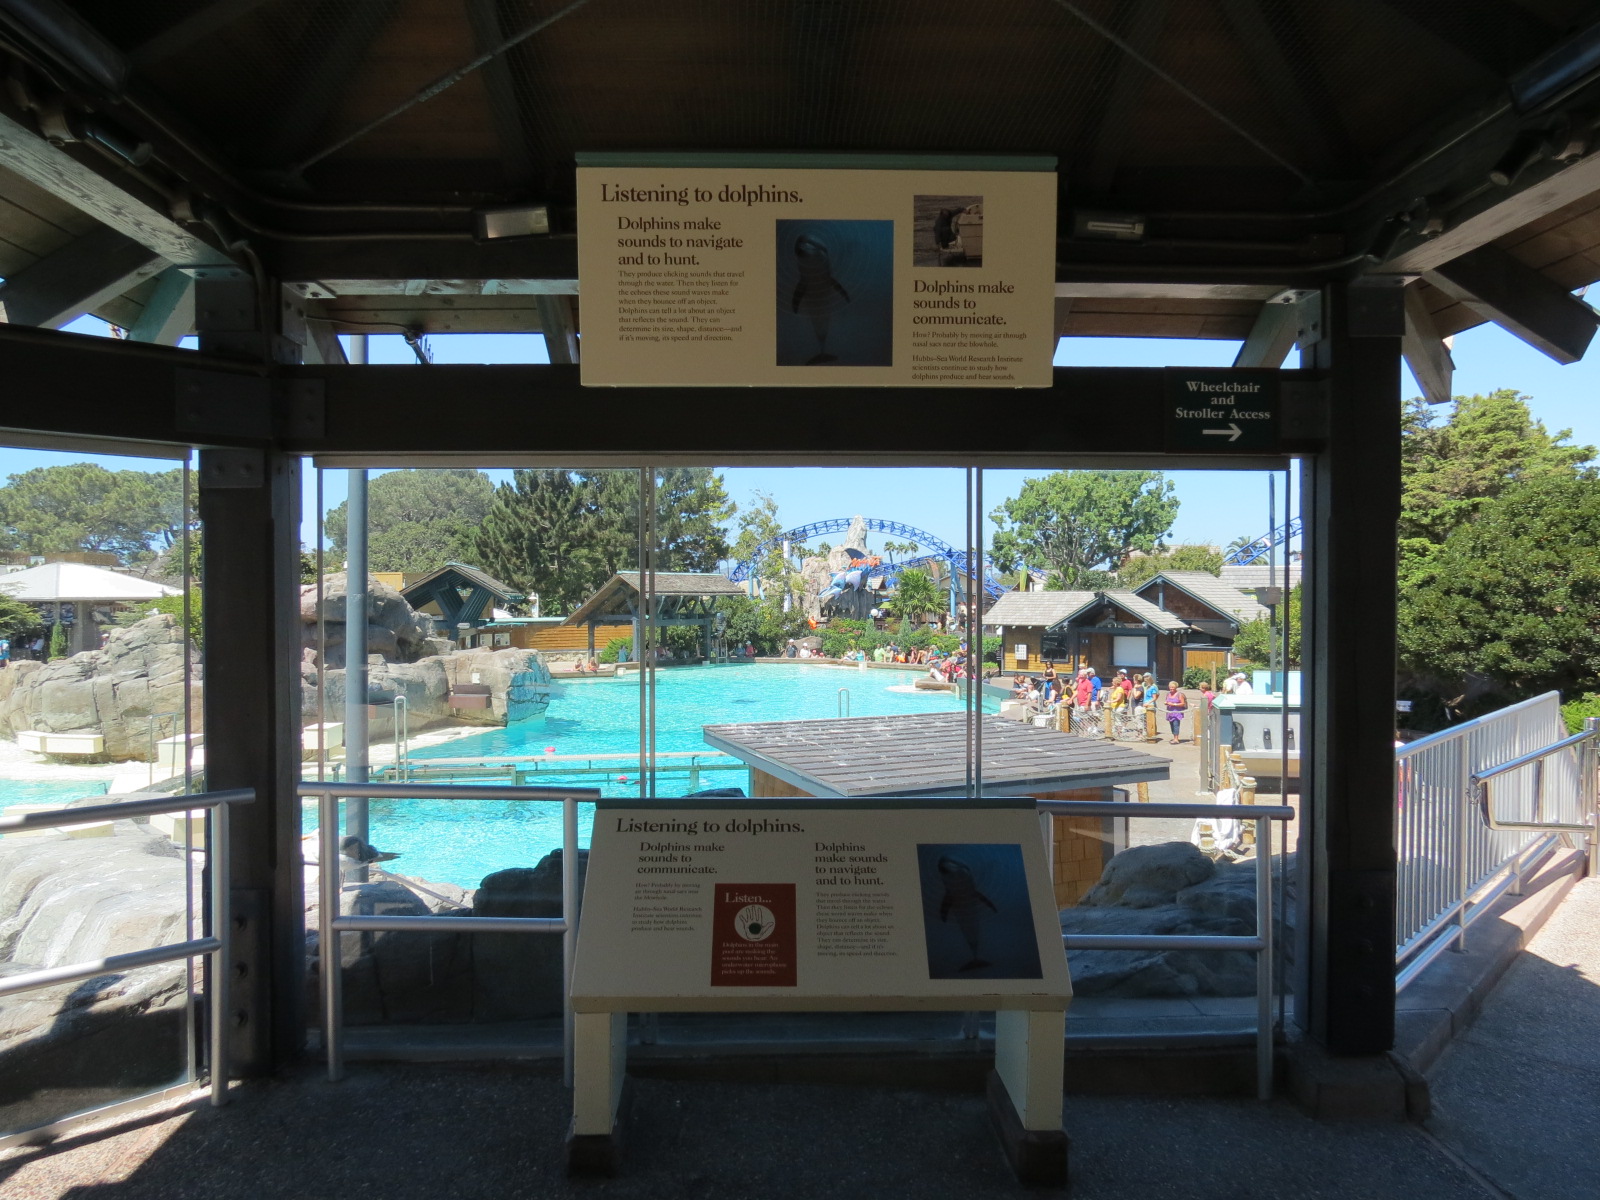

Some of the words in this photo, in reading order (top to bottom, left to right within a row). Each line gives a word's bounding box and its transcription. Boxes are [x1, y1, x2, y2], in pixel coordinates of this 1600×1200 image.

[602, 183, 690, 207] Listening
[694, 187, 713, 203] to
[718, 184, 803, 207] dolphins.
[618, 216, 680, 233] Dolphins
[683, 216, 721, 231] make
[617, 234, 667, 248] sounds
[669, 237, 683, 248] to
[686, 234, 744, 251] navigate
[618, 251, 644, 266] and
[647, 254, 661, 266] to
[664, 252, 700, 266] hunt.
[617, 270, 636, 278] They
[636, 270, 663, 279] produce
[663, 270, 689, 279] clicking
[689, 270, 712, 278] sounds
[713, 270, 726, 278] that
[726, 270, 745, 278] travel
[618, 279, 643, 288] through
[644, 279, 655, 287] the
[676, 279, 695, 287] Then
[695, 279, 710, 288] they
[711, 279, 729, 287] listen
[729, 279, 739, 287] for
[914, 279, 975, 296] Dolphins
[977, 280, 1015, 294] make
[618, 288, 629, 296] the
[671, 288, 691, 296] sound
[696, 298, 718, 306] object.
[913, 296, 960, 309] sounds
[963, 298, 977, 310] to
[618, 307, 648, 316] Dolphins
[716, 307, 736, 316] object
[912, 311, 1007, 326] communicate.
[676, 325, 697, 333] shape,
[670, 334, 690, 343] speed
[931, 331, 960, 340] Probably
[960, 331, 968, 340] by
[1002, 332, 1027, 340] through
[969, 340, 999, 348] blowhole.
[976, 364, 994, 372] study
[911, 373, 939, 381] dolphins
[939, 373, 965, 382] produce
[1186, 381, 1261, 393] Wheelchair
[1210, 394, 1235, 405] and
[1175, 407, 1225, 419] Stroller
[1229, 408, 1271, 420] Access
[616, 817, 698, 836] Listening
[703, 820, 721, 833] to
[724, 818, 805, 836] dolphins.
[640, 841, 691, 854] Dolphins
[693, 842, 725, 852] make
[815, 842, 866, 854] Dolphins
[638, 852, 678, 863] sounds
[680, 854, 692, 863] to
[815, 852, 846, 863] make
[848, 852, 888, 863] sounds
[637, 864, 718, 874] communicate.
[815, 865, 827, 874] to
[829, 863, 877, 876] navigate
[815, 875, 837, 886] and
[839, 877, 852, 886] to
[854, 875, 884, 886] hunt.
[725, 892, 772, 903] Listen...
